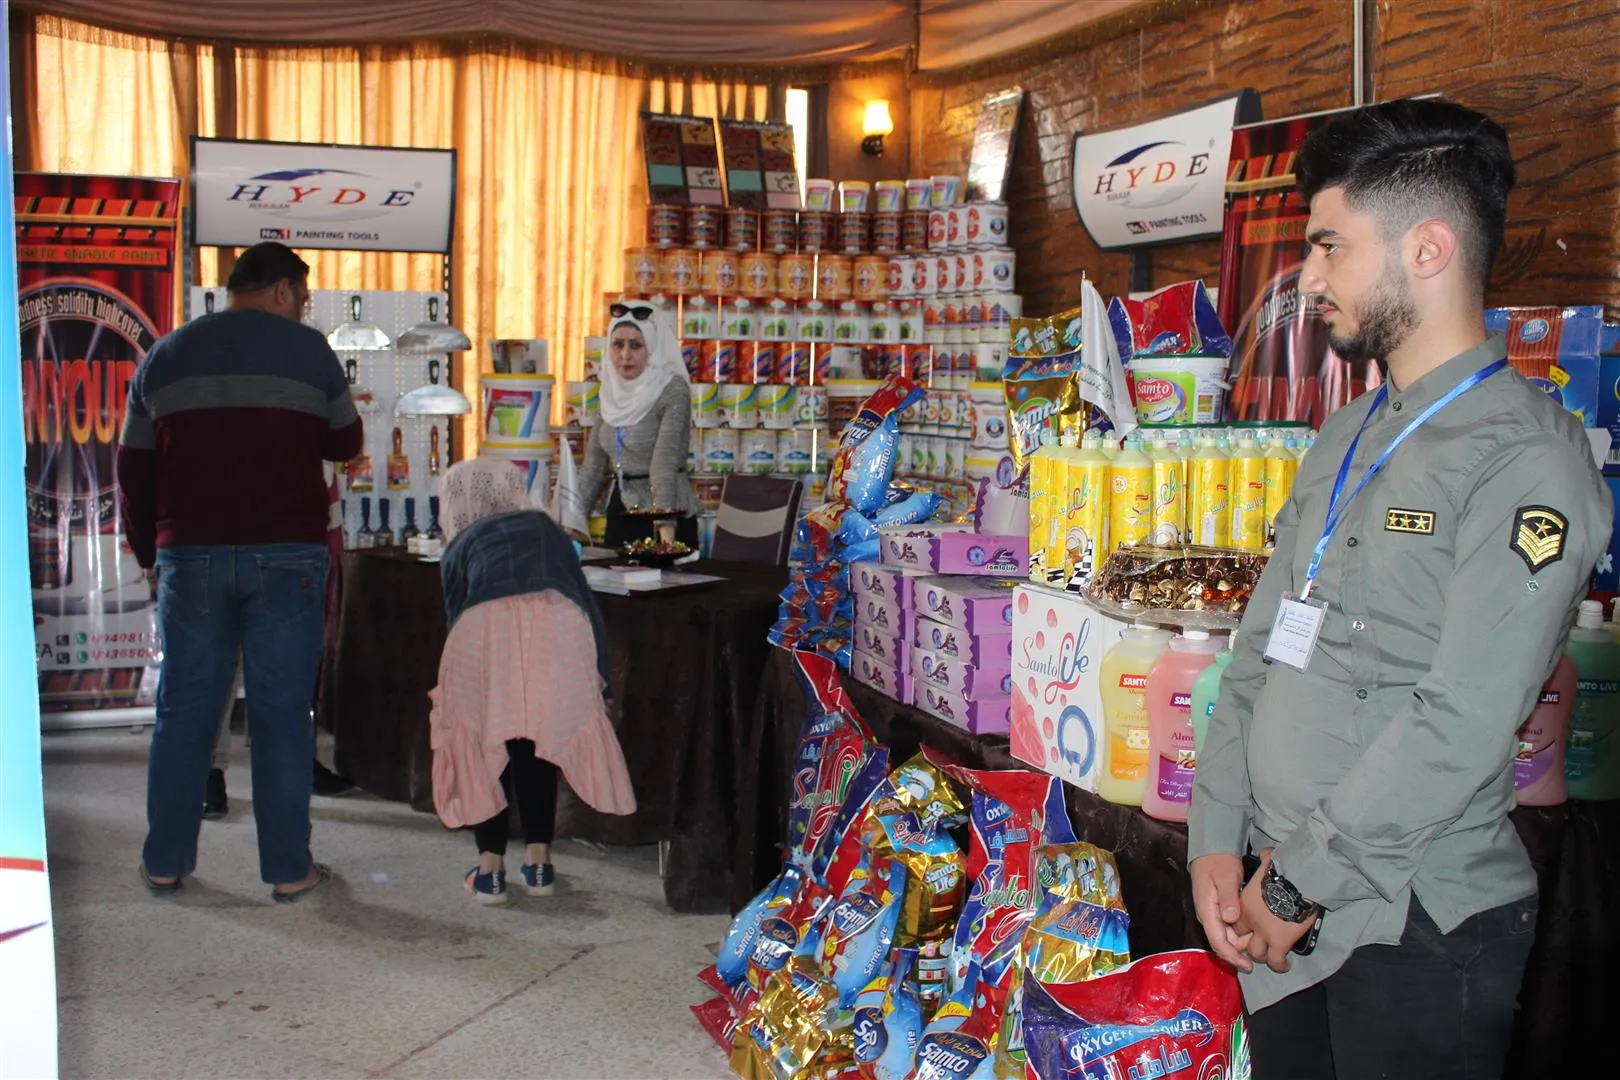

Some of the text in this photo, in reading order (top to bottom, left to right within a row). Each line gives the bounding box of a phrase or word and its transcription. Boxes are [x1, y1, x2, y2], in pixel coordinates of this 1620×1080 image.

[1093, 152, 1210, 195] HYDE
[226, 185, 415, 207] HYDE
[1149, 216, 1183, 229] PAINTING
[1182, 213, 1208, 223] TOOLS
[296, 231, 344, 241] PAINTING
[347, 232, 380, 241] TOOLS
[57, 291, 94, 316] solidity
[1137, 382, 1170, 395] Samto
[1018, 636, 1058, 678] Samto
